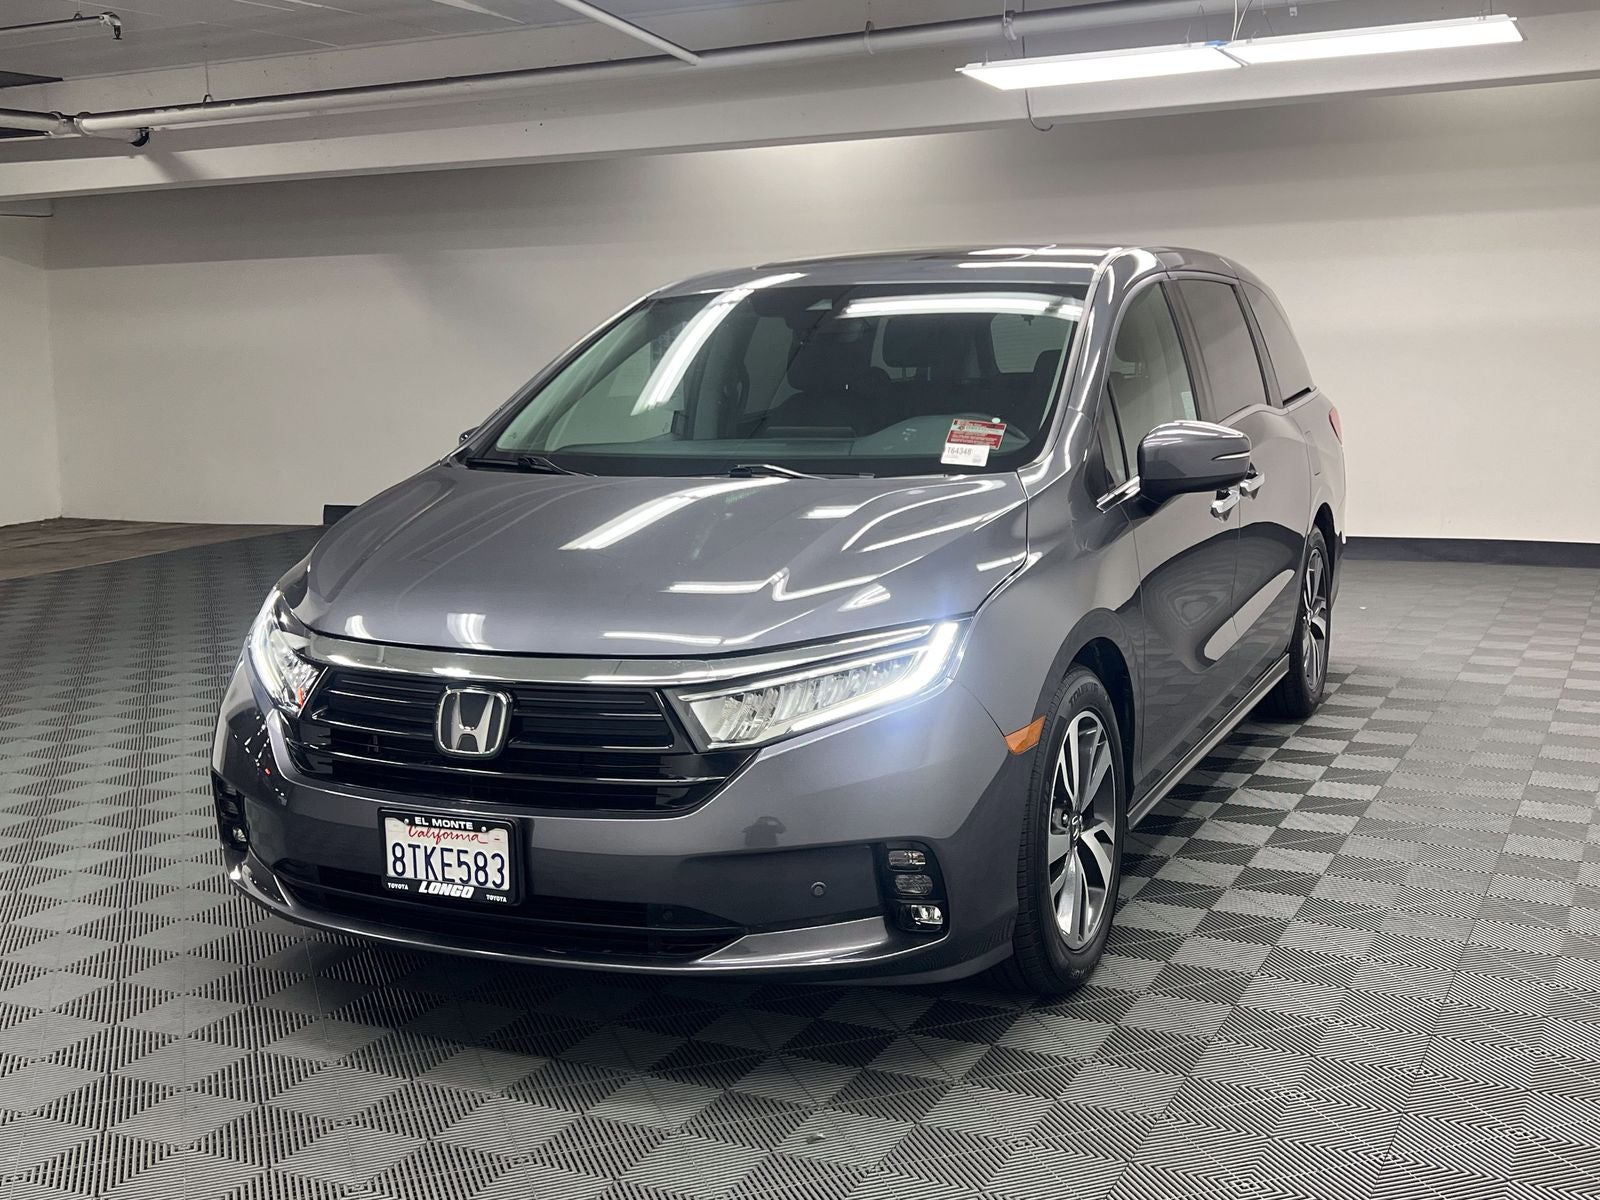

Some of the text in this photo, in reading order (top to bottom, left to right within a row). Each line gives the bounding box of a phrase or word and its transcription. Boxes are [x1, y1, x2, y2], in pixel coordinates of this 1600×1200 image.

[414, 816, 474, 830] EL MONTE
[408, 825, 488, 845] California
[392, 842, 505, 889] 8TKE583
[387, 882, 409, 891] TOYOTA
[418, 880, 475, 899] LONGO
[486, 894, 508, 903] TOYOTA
